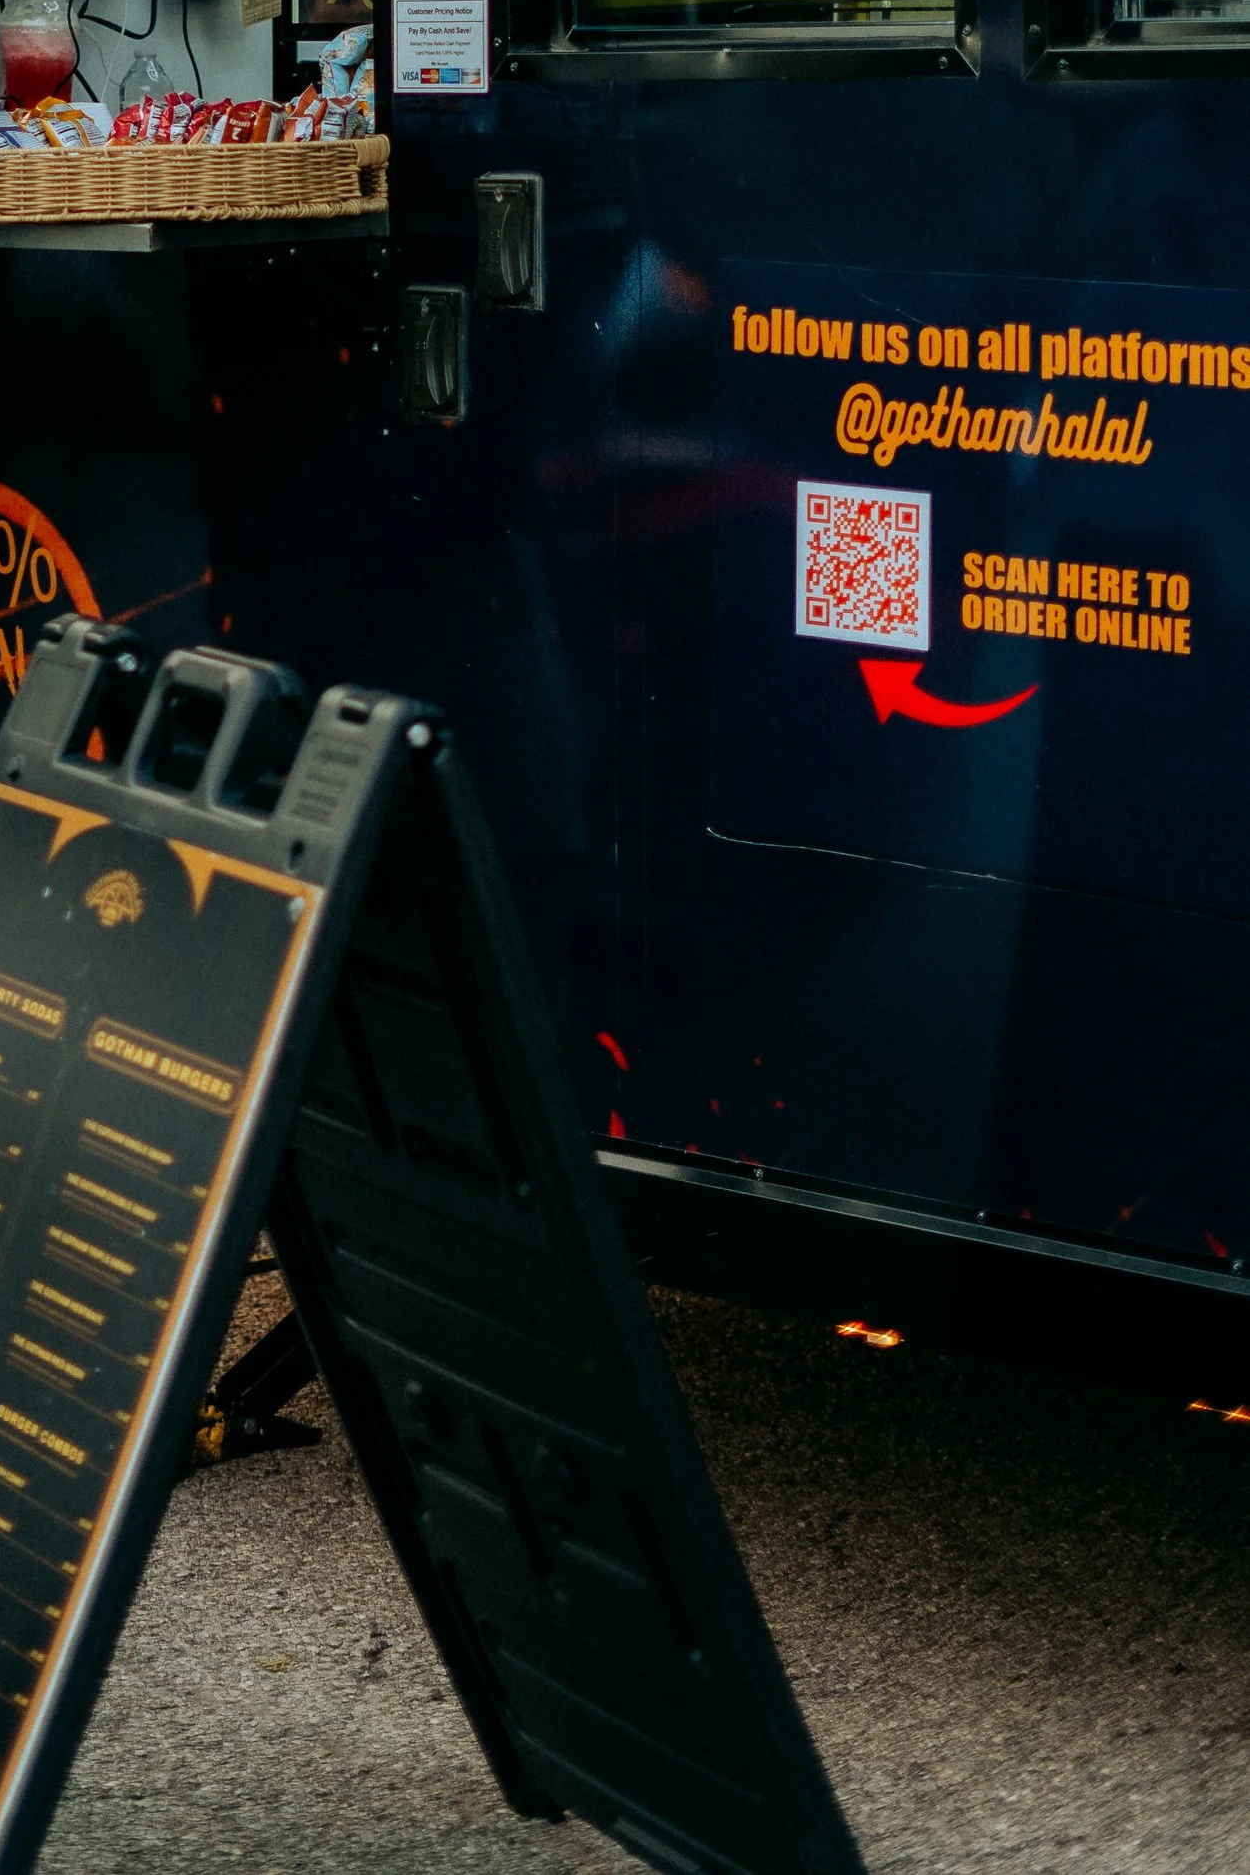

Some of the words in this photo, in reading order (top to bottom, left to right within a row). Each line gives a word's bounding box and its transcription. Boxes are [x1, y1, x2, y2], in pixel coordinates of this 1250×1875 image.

[408, 27, 418, 35] Pay
[419, 27, 427, 35] By
[456, 26, 471, 34] Save!
[435, 7, 453, 16] Pricing
[402, 71, 419, 81] VISA
[732, 305, 853, 360] follow
[860, 323, 909, 365] us
[918, 326, 969, 368] on
[978, 323, 1030, 372] all
[1041, 327, 1250, 390] platforms
[836, 382, 1153, 467] @gothamhalal
[963, 552, 1049, 596] SCAN
[1057, 562, 1139, 606] HERE
[1146, 572, 1190, 612] TO
[961, 594, 1067, 639] ORDER
[1075, 606, 1191, 655] ONLINE
[20, 996, 63, 1027] SODAS
[92, 1028, 157, 1071] GOTHAM
[157, 1055, 234, 1103] BURGERS
